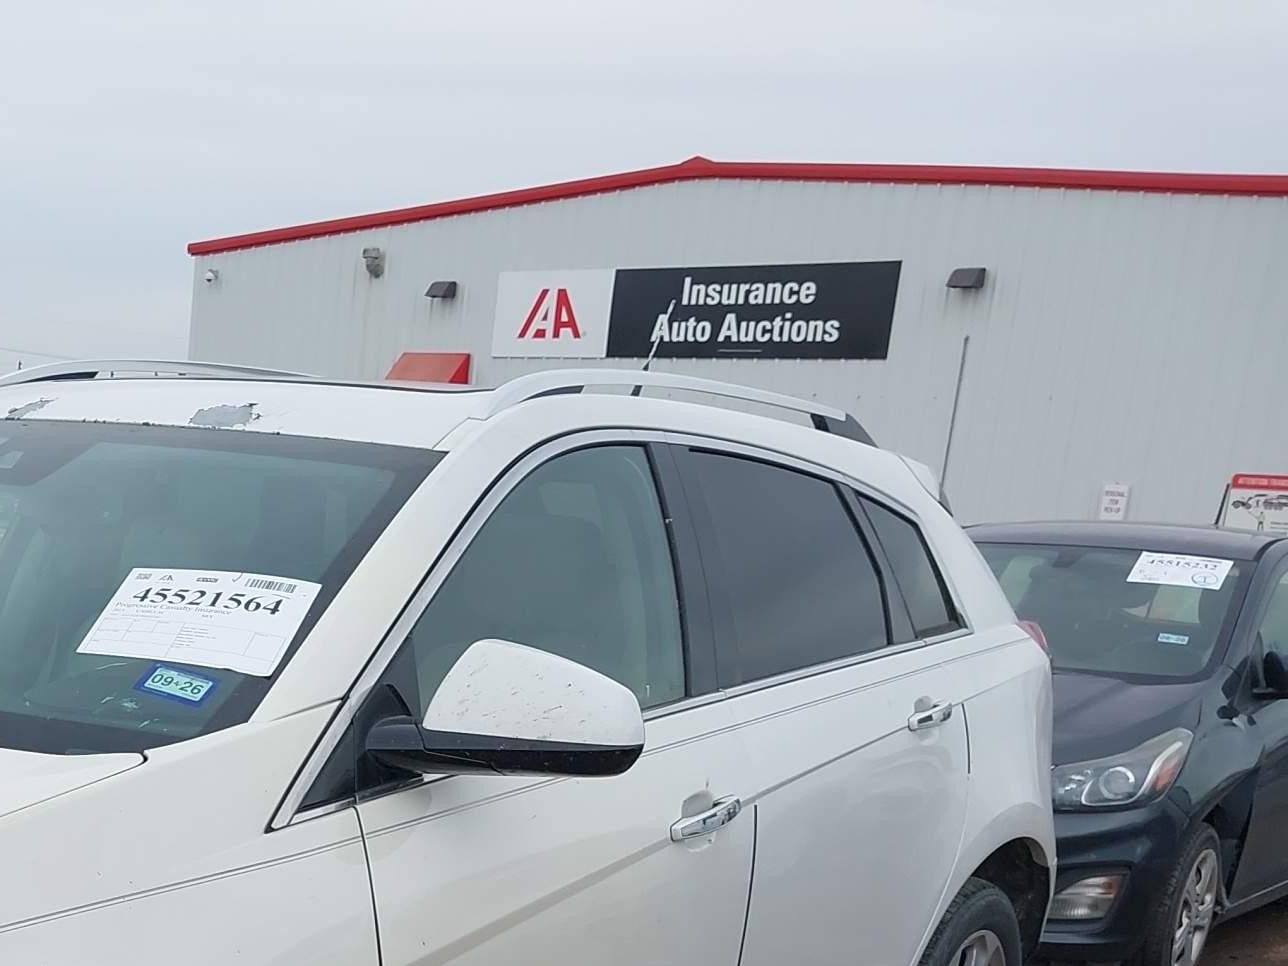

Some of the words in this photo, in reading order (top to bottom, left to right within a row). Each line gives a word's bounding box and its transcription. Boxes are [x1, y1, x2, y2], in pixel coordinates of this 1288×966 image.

[681, 276, 816, 306] Insurance
[651, 315, 712, 343] Auto
[717, 313, 840, 343] Auctions
[132, 586, 283, 616] 45521564
[194, 606, 233, 616] Insurance
[151, 673, 174, 686] 09
[179, 681, 204, 695] 26
